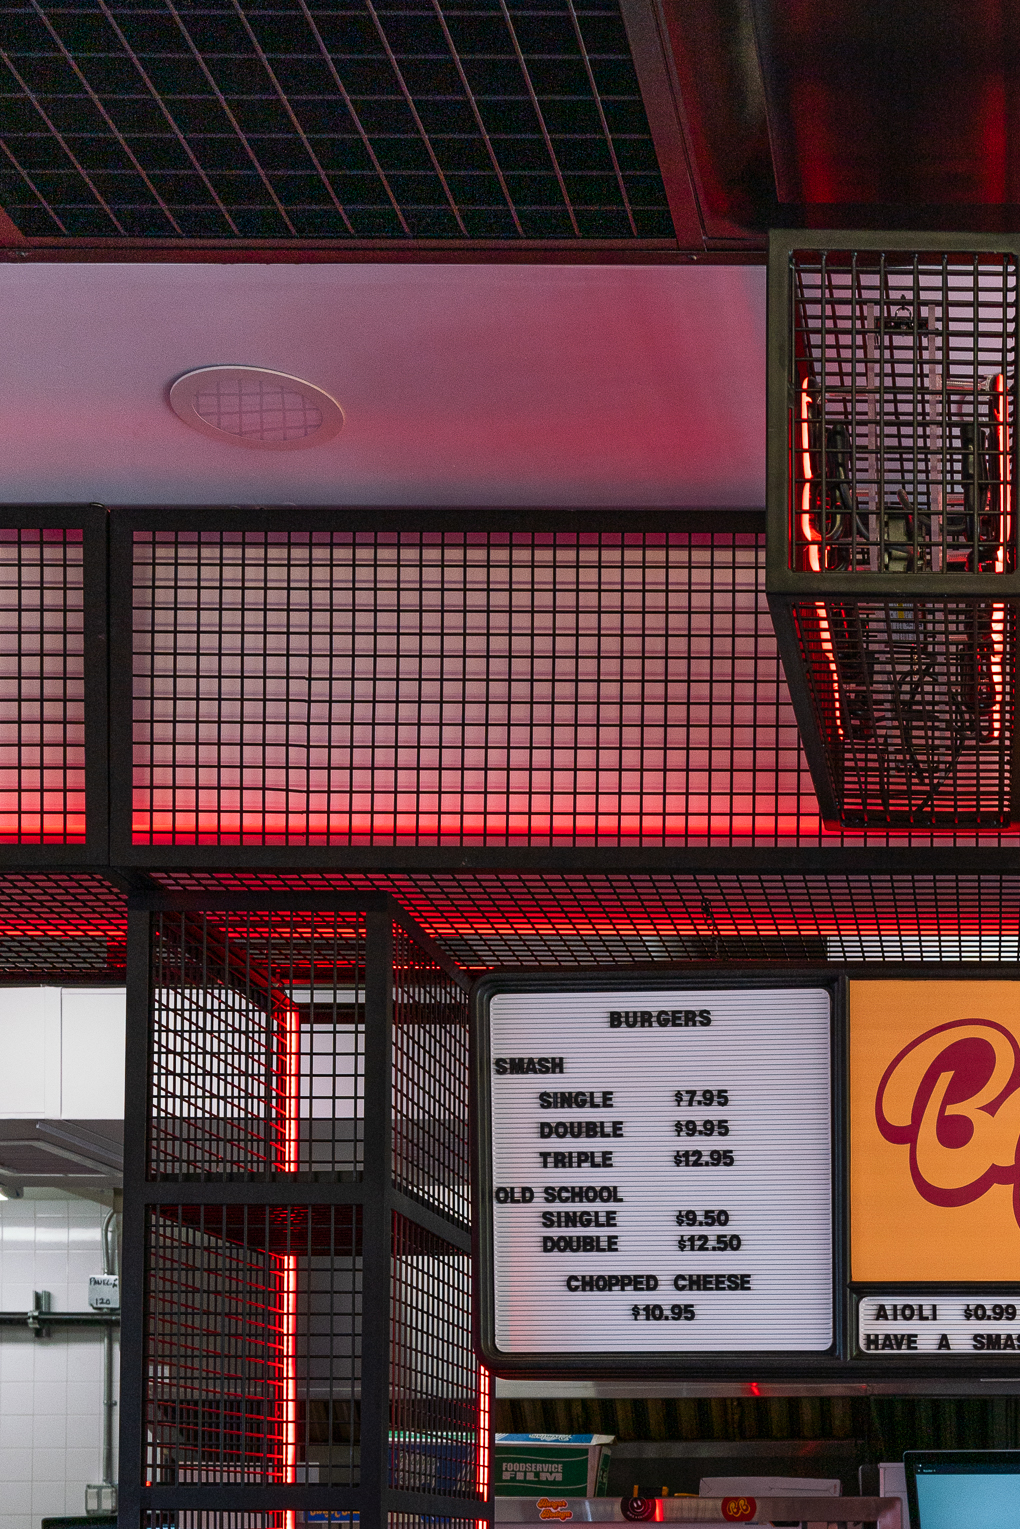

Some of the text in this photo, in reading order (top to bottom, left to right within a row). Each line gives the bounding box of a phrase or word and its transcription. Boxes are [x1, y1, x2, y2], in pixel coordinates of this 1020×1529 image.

[609, 1009, 712, 1028] BURGERS
[495, 1057, 564, 1075] SMASH
[539, 1089, 729, 1109] SINGLE $7.95
[539, 1119, 730, 1139] DOUBLE $9.95
[539, 1149, 734, 1169] TRIPLE $12.95
[495, 1185, 624, 1204] OLD SCHOOL
[541, 1209, 730, 1228] SINGLE $9.50
[542, 1234, 741, 1253] DOUBLE $12.50
[566, 1274, 752, 1292] CHOPPED CHEESE
[631, 1304, 695, 1321] $10.95
[875, 1304, 938, 1321] AIOLI
[963, 1304, 1017, 1321] $0.99
[865, 1334, 918, 1351] HAVE
[937, 1334, 951, 1351] A
[502, 1462, 563, 1473] FOODSERVICE
[502, 1472, 563, 1481] FILM
